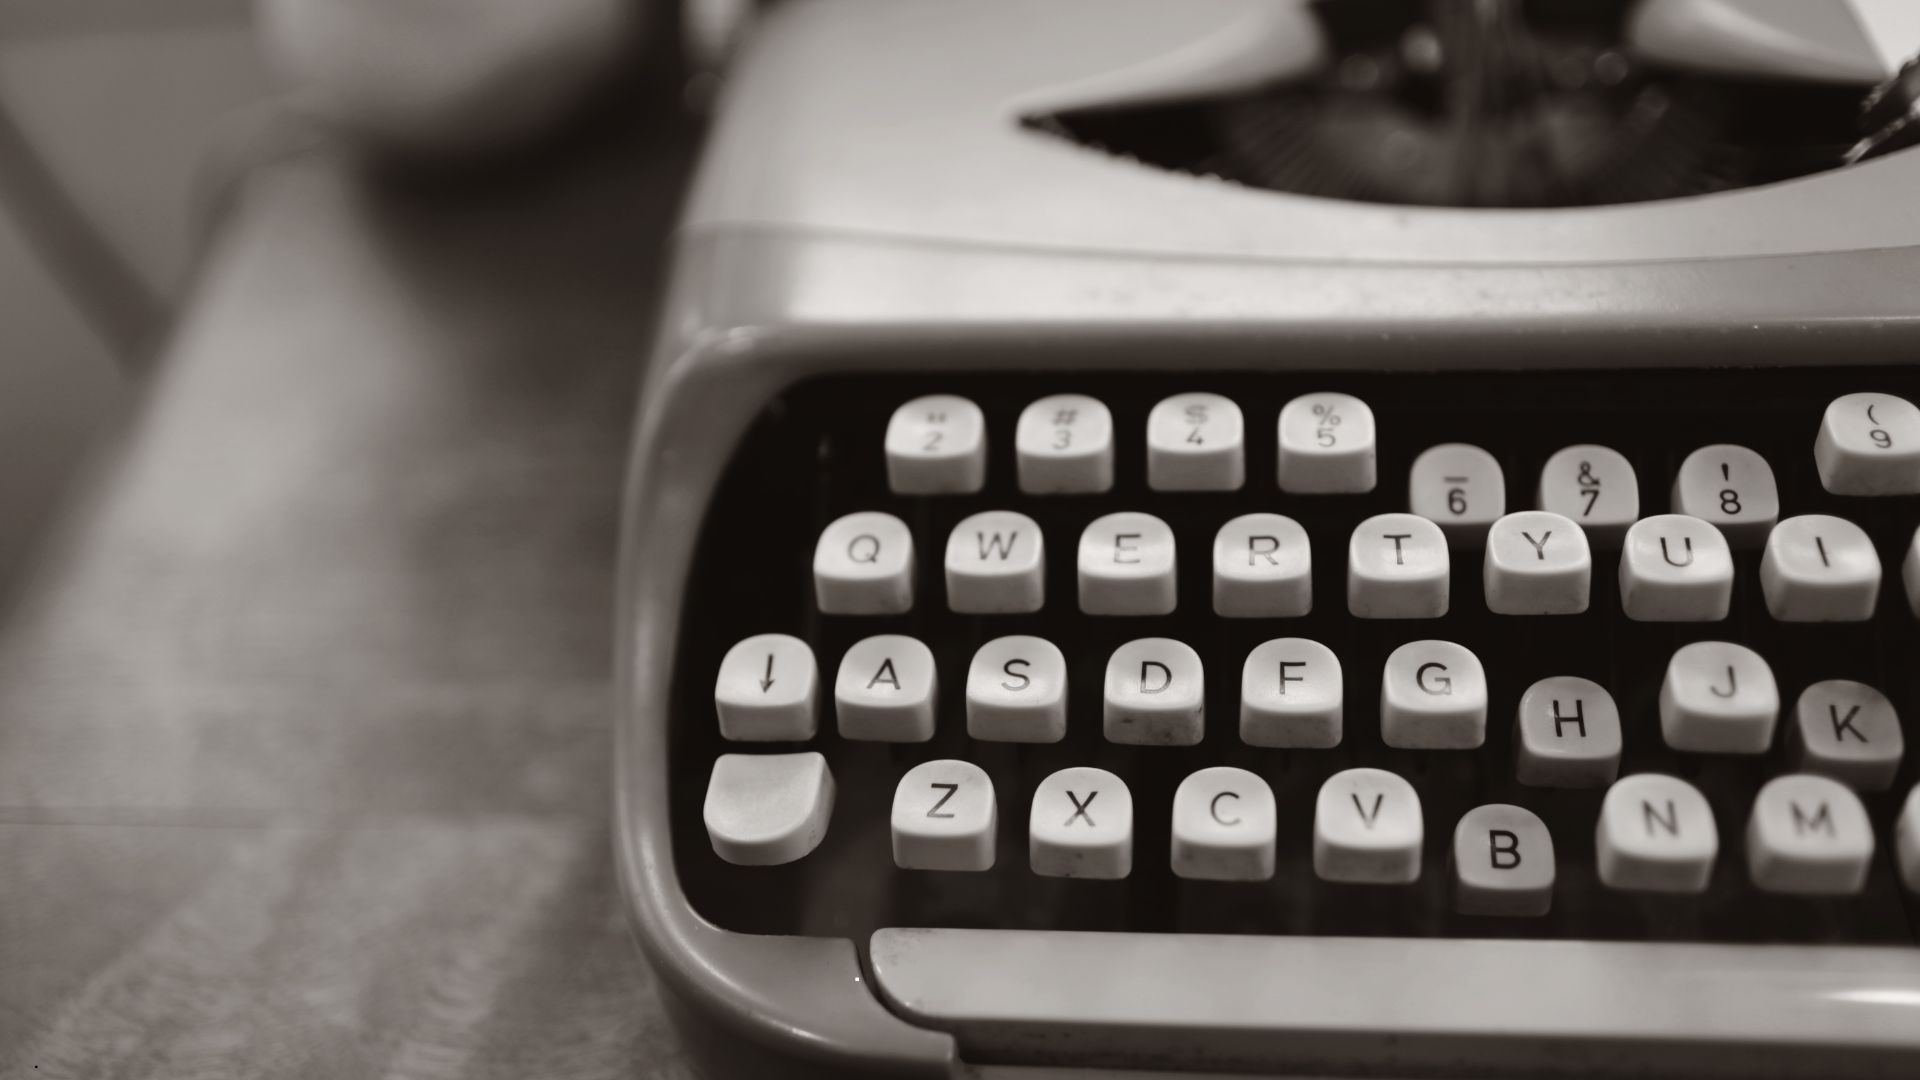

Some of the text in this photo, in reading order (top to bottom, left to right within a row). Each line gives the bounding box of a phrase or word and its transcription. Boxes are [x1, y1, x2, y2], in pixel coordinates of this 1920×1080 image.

[1052, 408, 1079, 427] #
[1312, 404, 1341, 428] %
[1867, 404, 1880, 425] (
[922, 431, 943, 452] 2
[1052, 430, 1072, 450] 3
[1186, 427, 1206, 446] 4
[1317, 428, 1336, 448] 5
[1869, 429, 1892, 449] 9
[1577, 461, 1600, 487] &
[1447, 488, 1467, 515] 6
[1580, 490, 1600, 517] 7
[1720, 489, 1742, 515] 8
[849, 534, 880, 564] Q
[975, 530, 1018, 562] W
[1113, 533, 1142, 564] E
[1248, 535, 1280, 566] R
[1383, 534, 1412, 565] T
[1521, 530, 1552, 560] Y
[1660, 536, 1692, 567] U
[1815, 536, 1831, 568] I
[866, 657, 902, 690] A
[1001, 659, 1032, 692] S
[1140, 661, 1172, 694] D
[1279, 661, 1306, 694] F
[1415, 662, 1451, 696] G
[1710, 665, 1736, 698] J
[1552, 699, 1587, 737] H
[1829, 703, 1869, 743] K
[926, 783, 959, 818] Z
[1063, 790, 1099, 827] X
[1210, 791, 1242, 826] C
[1351, 792, 1384, 829] V
[1641, 799, 1679, 837] N
[1789, 801, 1838, 839] M
[1489, 829, 1522, 869] B
